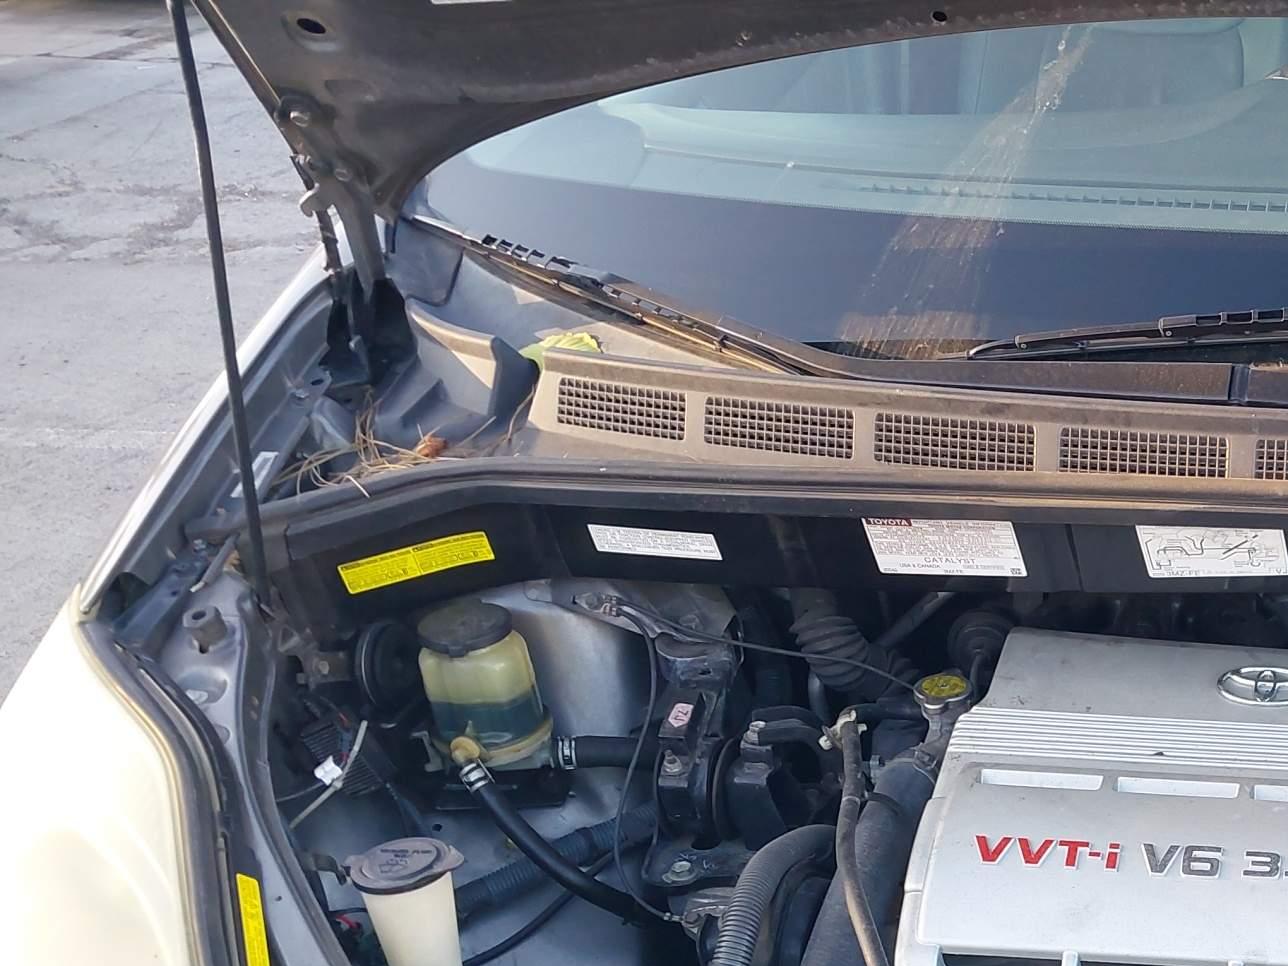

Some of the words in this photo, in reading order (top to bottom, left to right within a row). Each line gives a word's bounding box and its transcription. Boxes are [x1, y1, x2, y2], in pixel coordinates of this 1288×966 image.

[868, 518, 909, 526] TOYOTA
[974, 834, 1121, 872] VVT-i
[1141, 843, 1224, 879] V6
